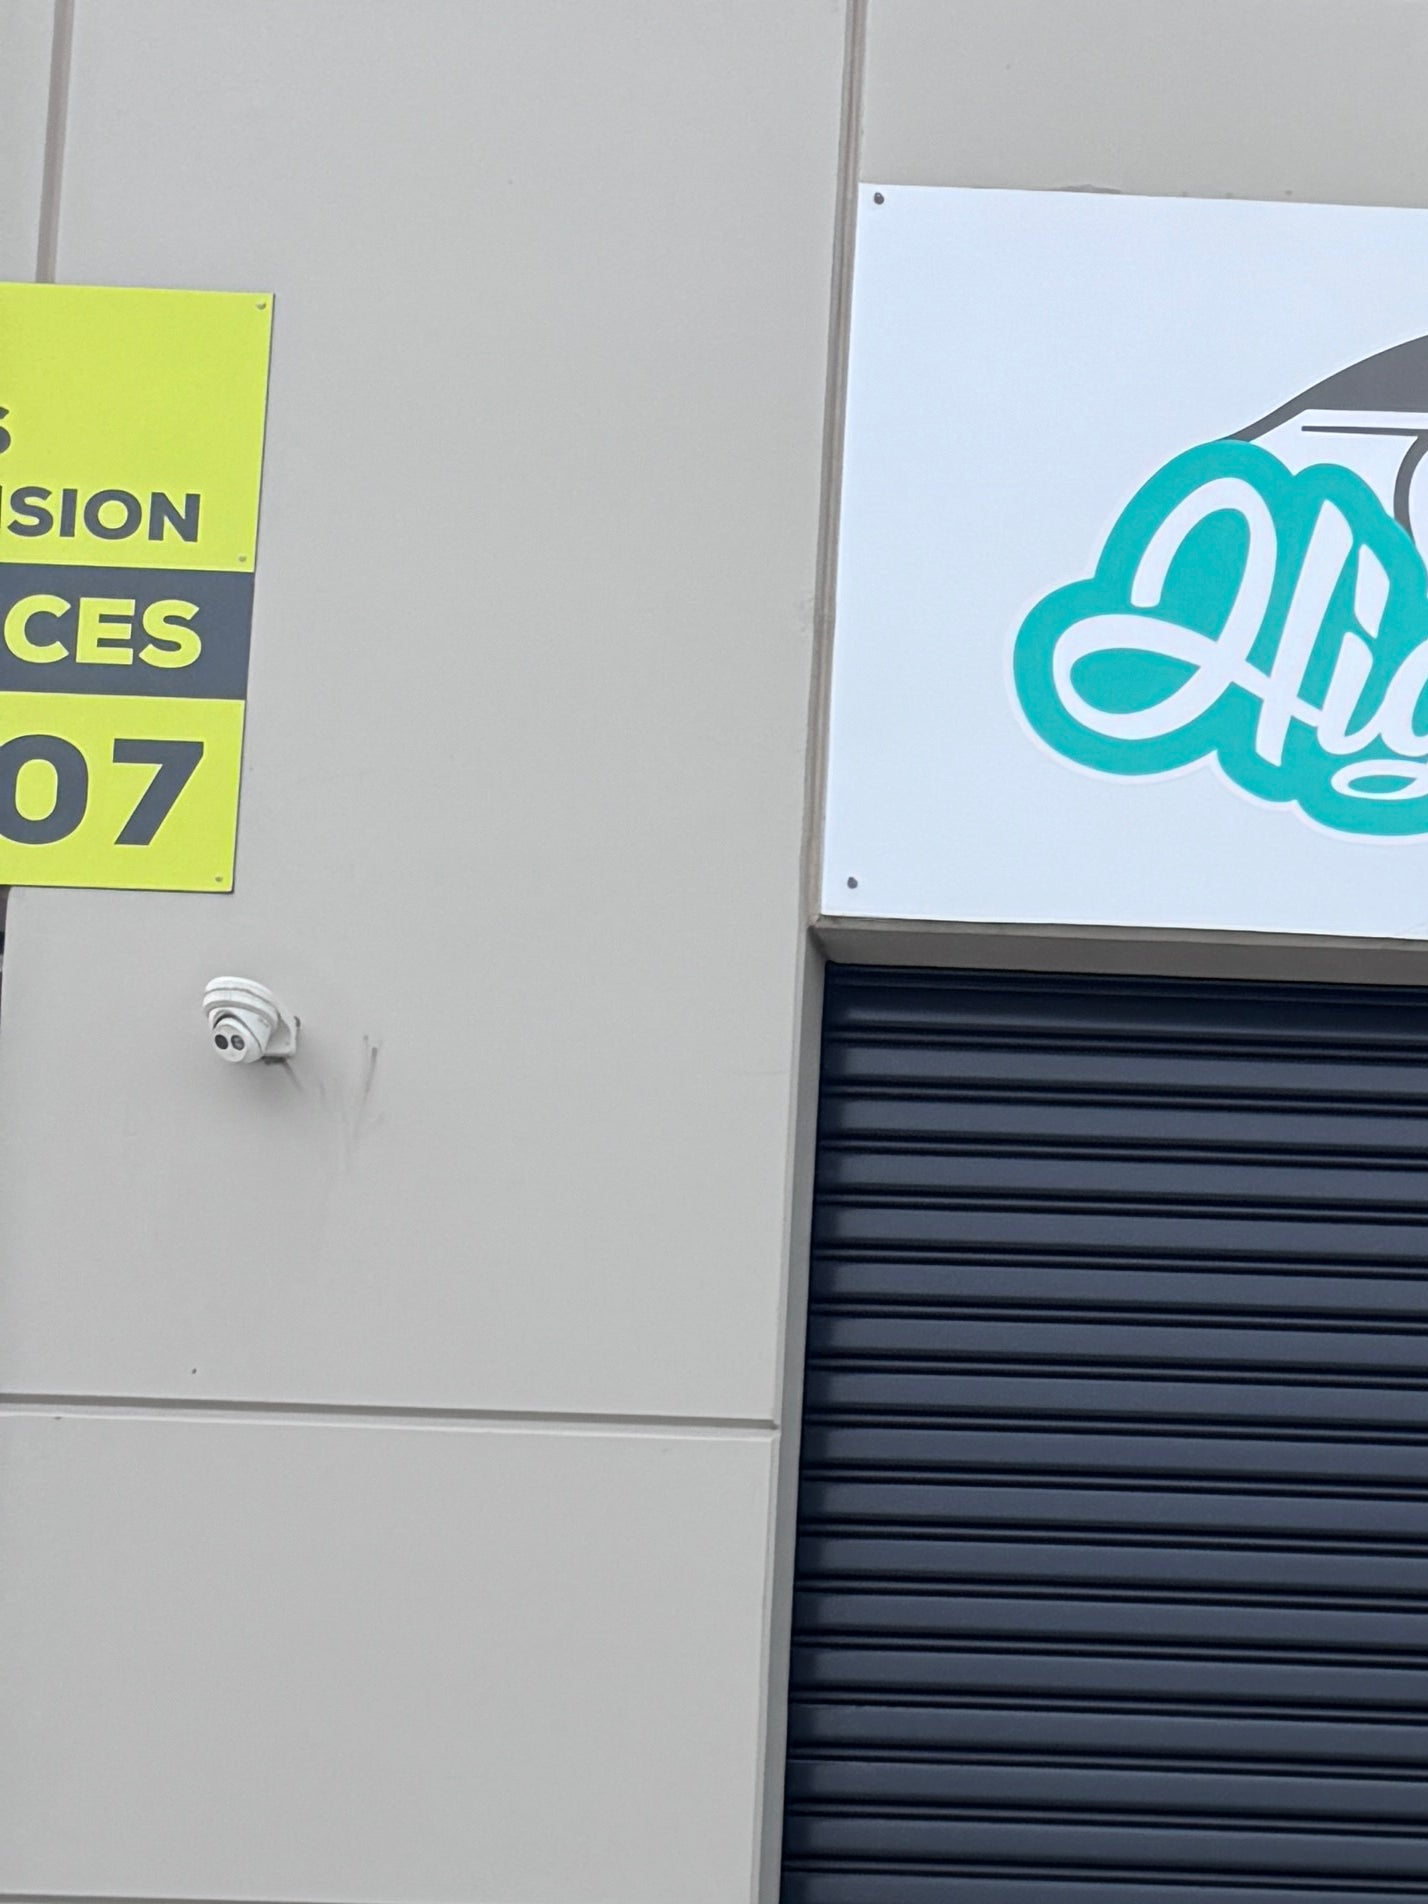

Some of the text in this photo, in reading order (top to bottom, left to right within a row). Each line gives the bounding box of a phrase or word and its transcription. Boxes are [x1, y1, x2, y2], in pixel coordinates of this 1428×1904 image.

[0, 486, 201, 543] SION
[3, 593, 202, 669] CES
[0, 734, 204, 846] 07
